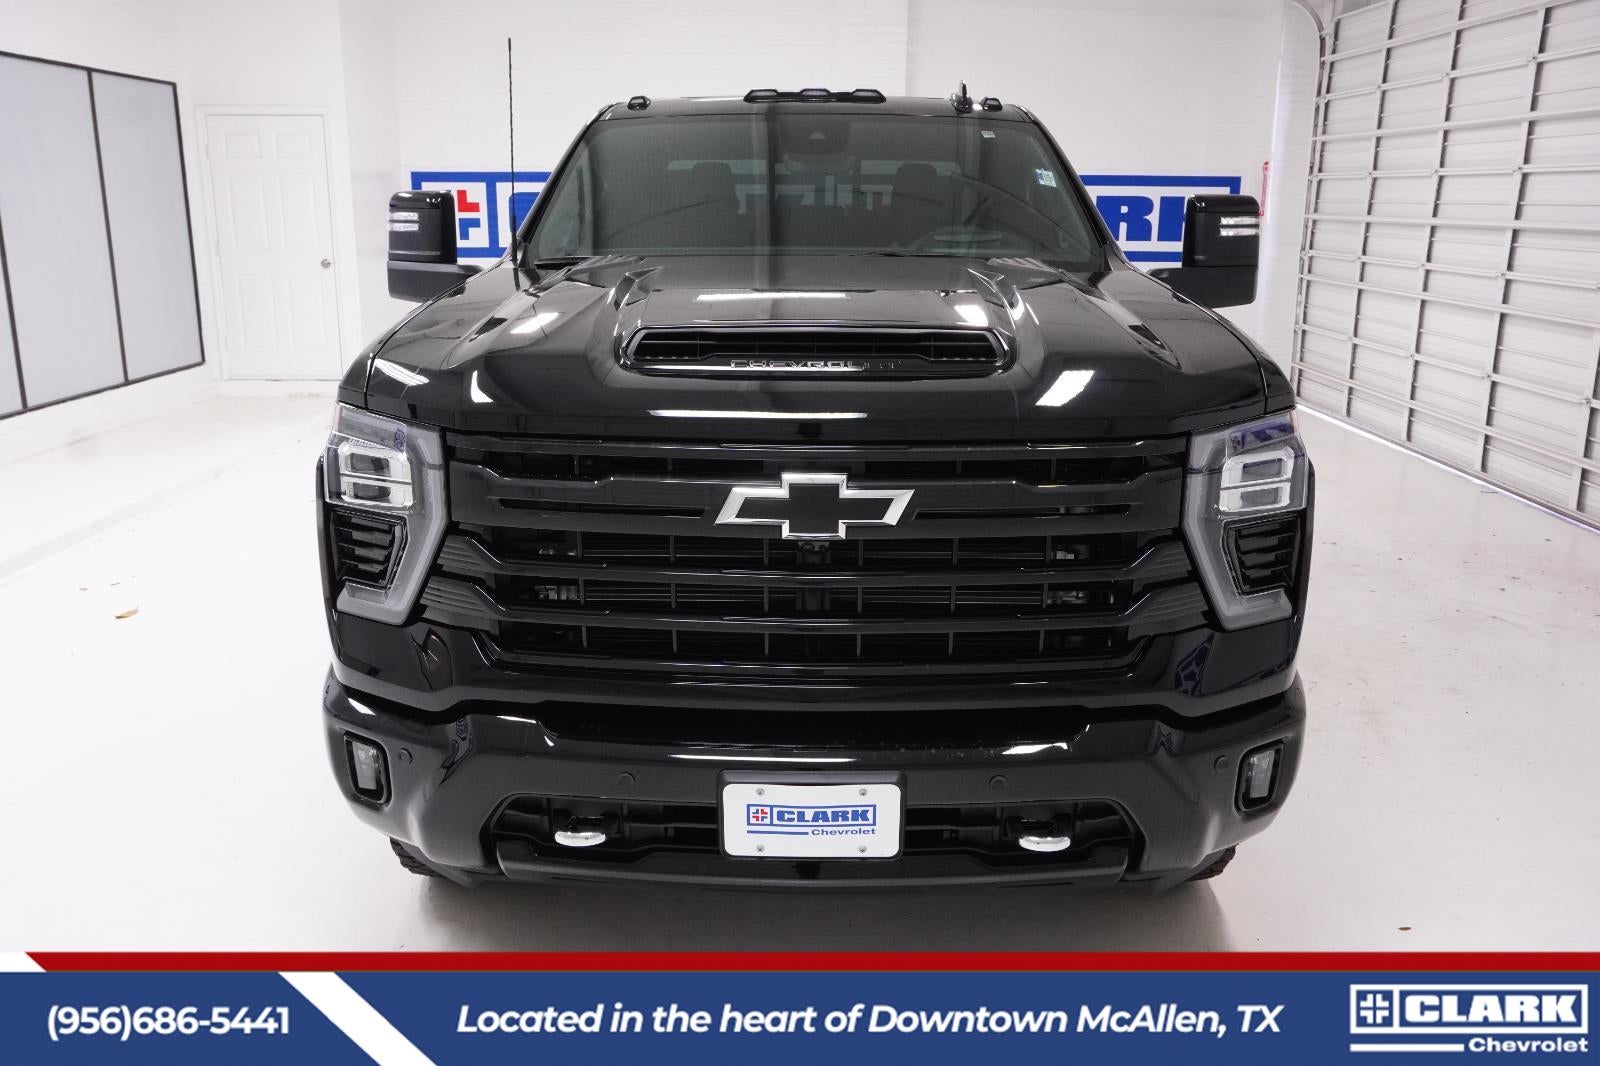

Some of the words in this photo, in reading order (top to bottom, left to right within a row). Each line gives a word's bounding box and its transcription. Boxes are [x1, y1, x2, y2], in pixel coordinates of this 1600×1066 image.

[730, 360, 900, 370] CHEVROL
[776, 809, 870, 823] CLARK
[811, 828, 876, 836] Chevrolet
